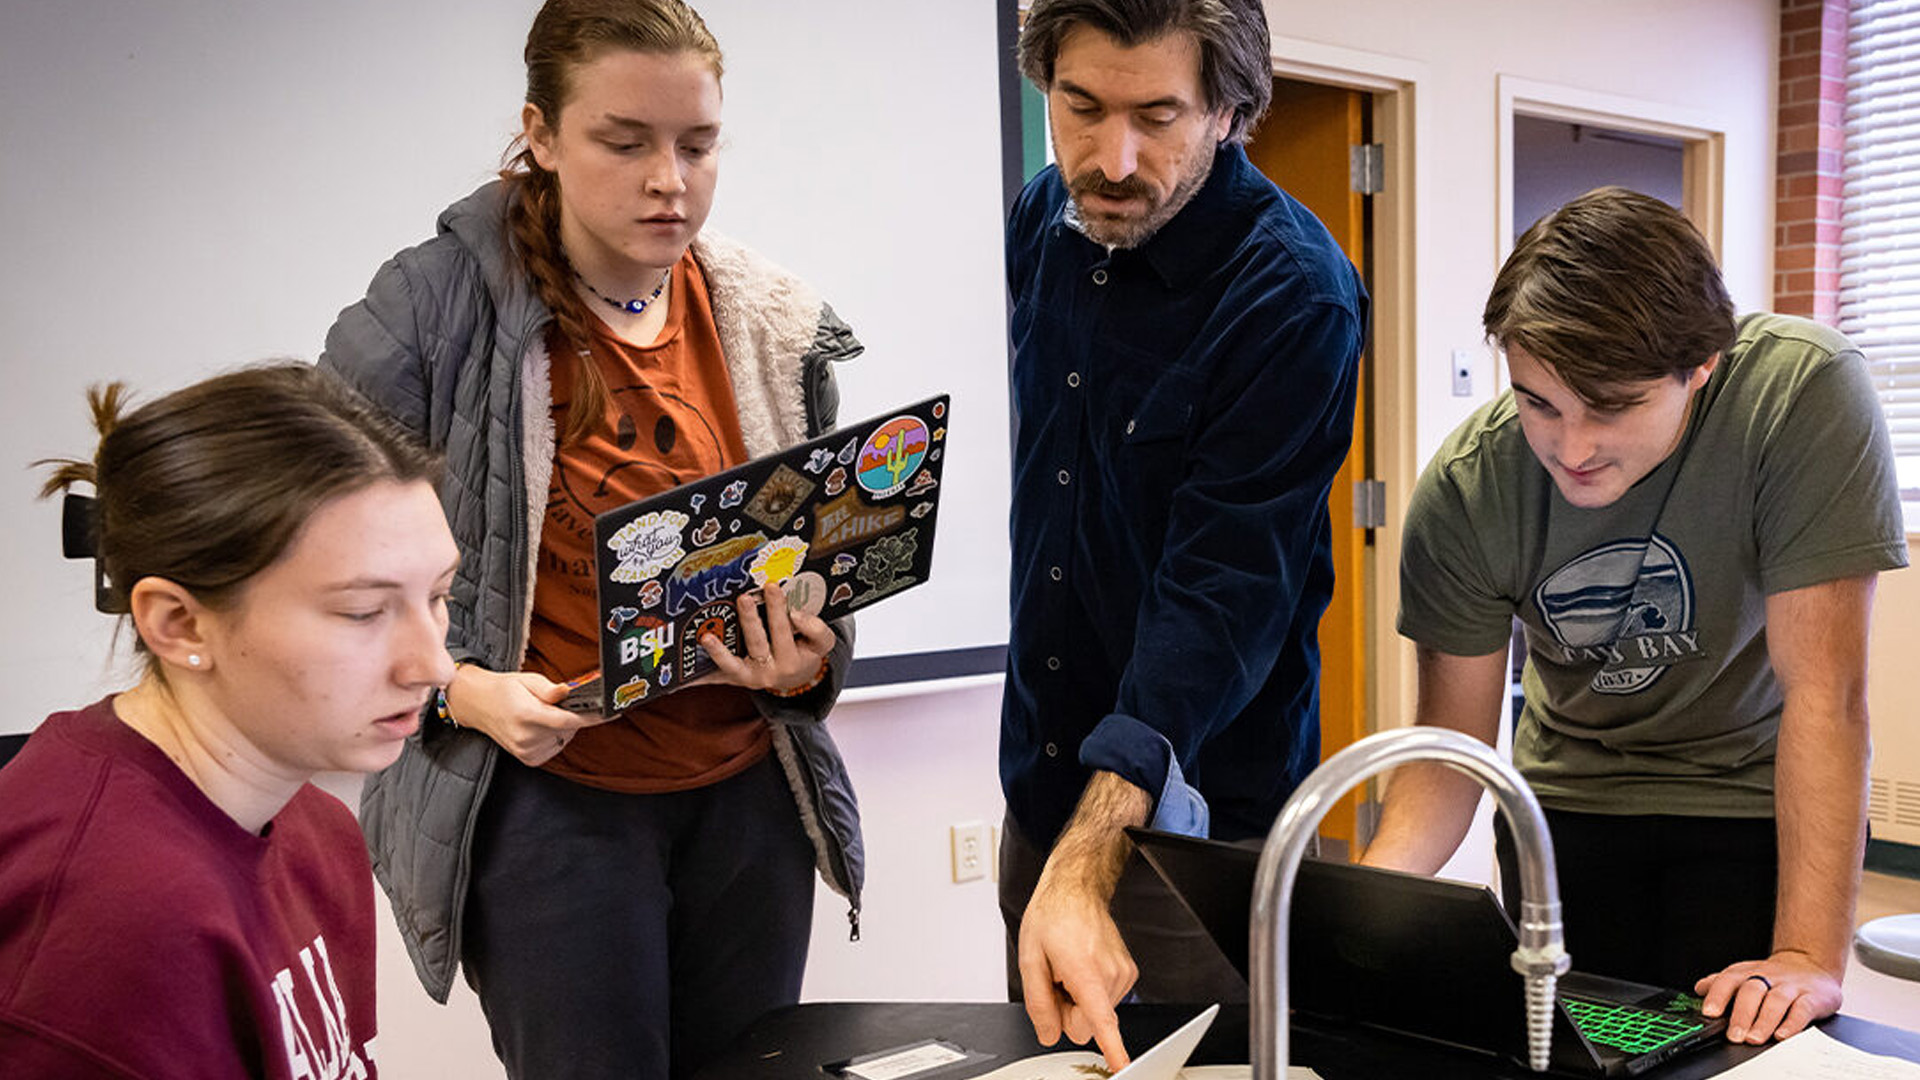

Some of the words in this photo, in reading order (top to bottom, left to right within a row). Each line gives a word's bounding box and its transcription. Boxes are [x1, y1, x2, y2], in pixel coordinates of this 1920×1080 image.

[610, 513, 659, 545] STAND
[661, 512, 688, 528] FOR
[619, 525, 665, 558] what
[841, 510, 900, 541] HIKE
[646, 534, 682, 560] you
[612, 564, 660, 580] STAND
[663, 549, 683, 567] ON
[685, 605, 736, 640] NATURE
[620, 621, 675, 665] BSU
[724, 624, 737, 655] WIL
[1637, 632, 1699, 660] BAY
[683, 644, 696, 678] KEEP
